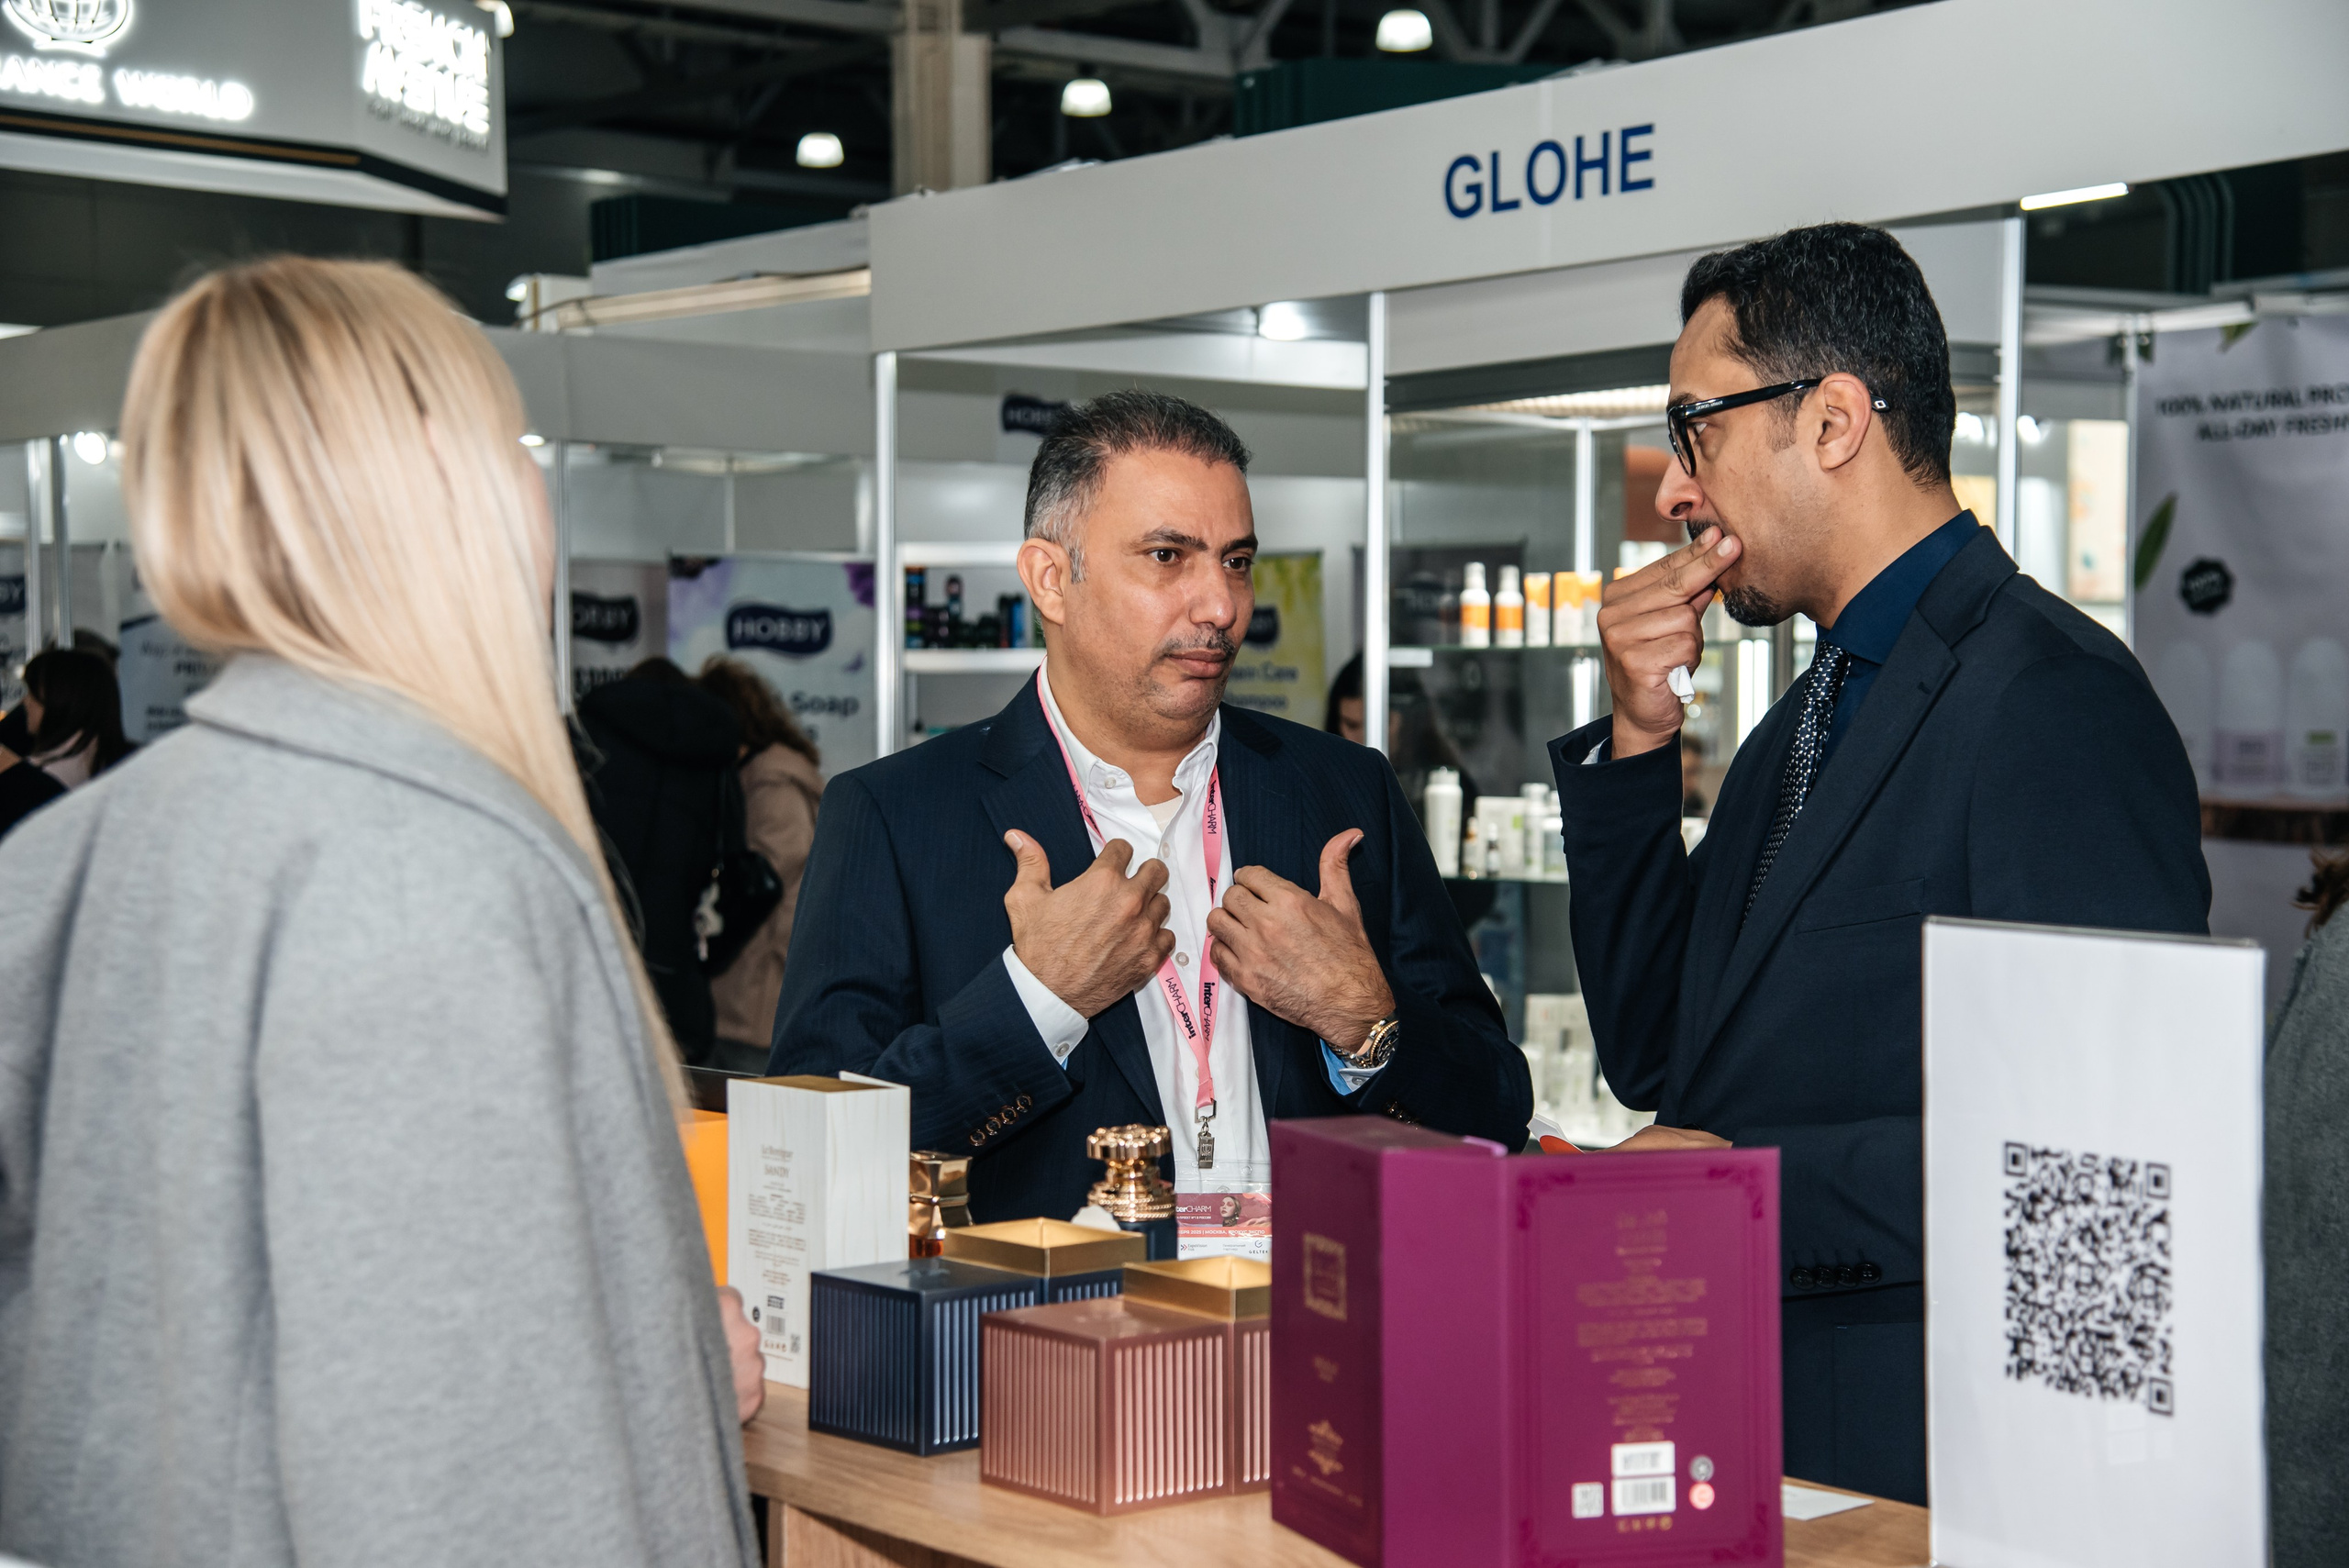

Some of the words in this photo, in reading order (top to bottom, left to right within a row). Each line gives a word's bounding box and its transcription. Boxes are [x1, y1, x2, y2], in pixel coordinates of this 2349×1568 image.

[113, 68, 252, 121] WORLD
[1444, 121, 1655, 219] GLOHE
[2209, 389, 2301, 412] NATURAL
[573, 605, 631, 630] OBBY
[733, 615, 827, 643] HOBBY
[791, 691, 860, 717] Soap
[1165, 976, 1197, 1040] interCHARM
[1203, 982, 1216, 1041] interCHARM
